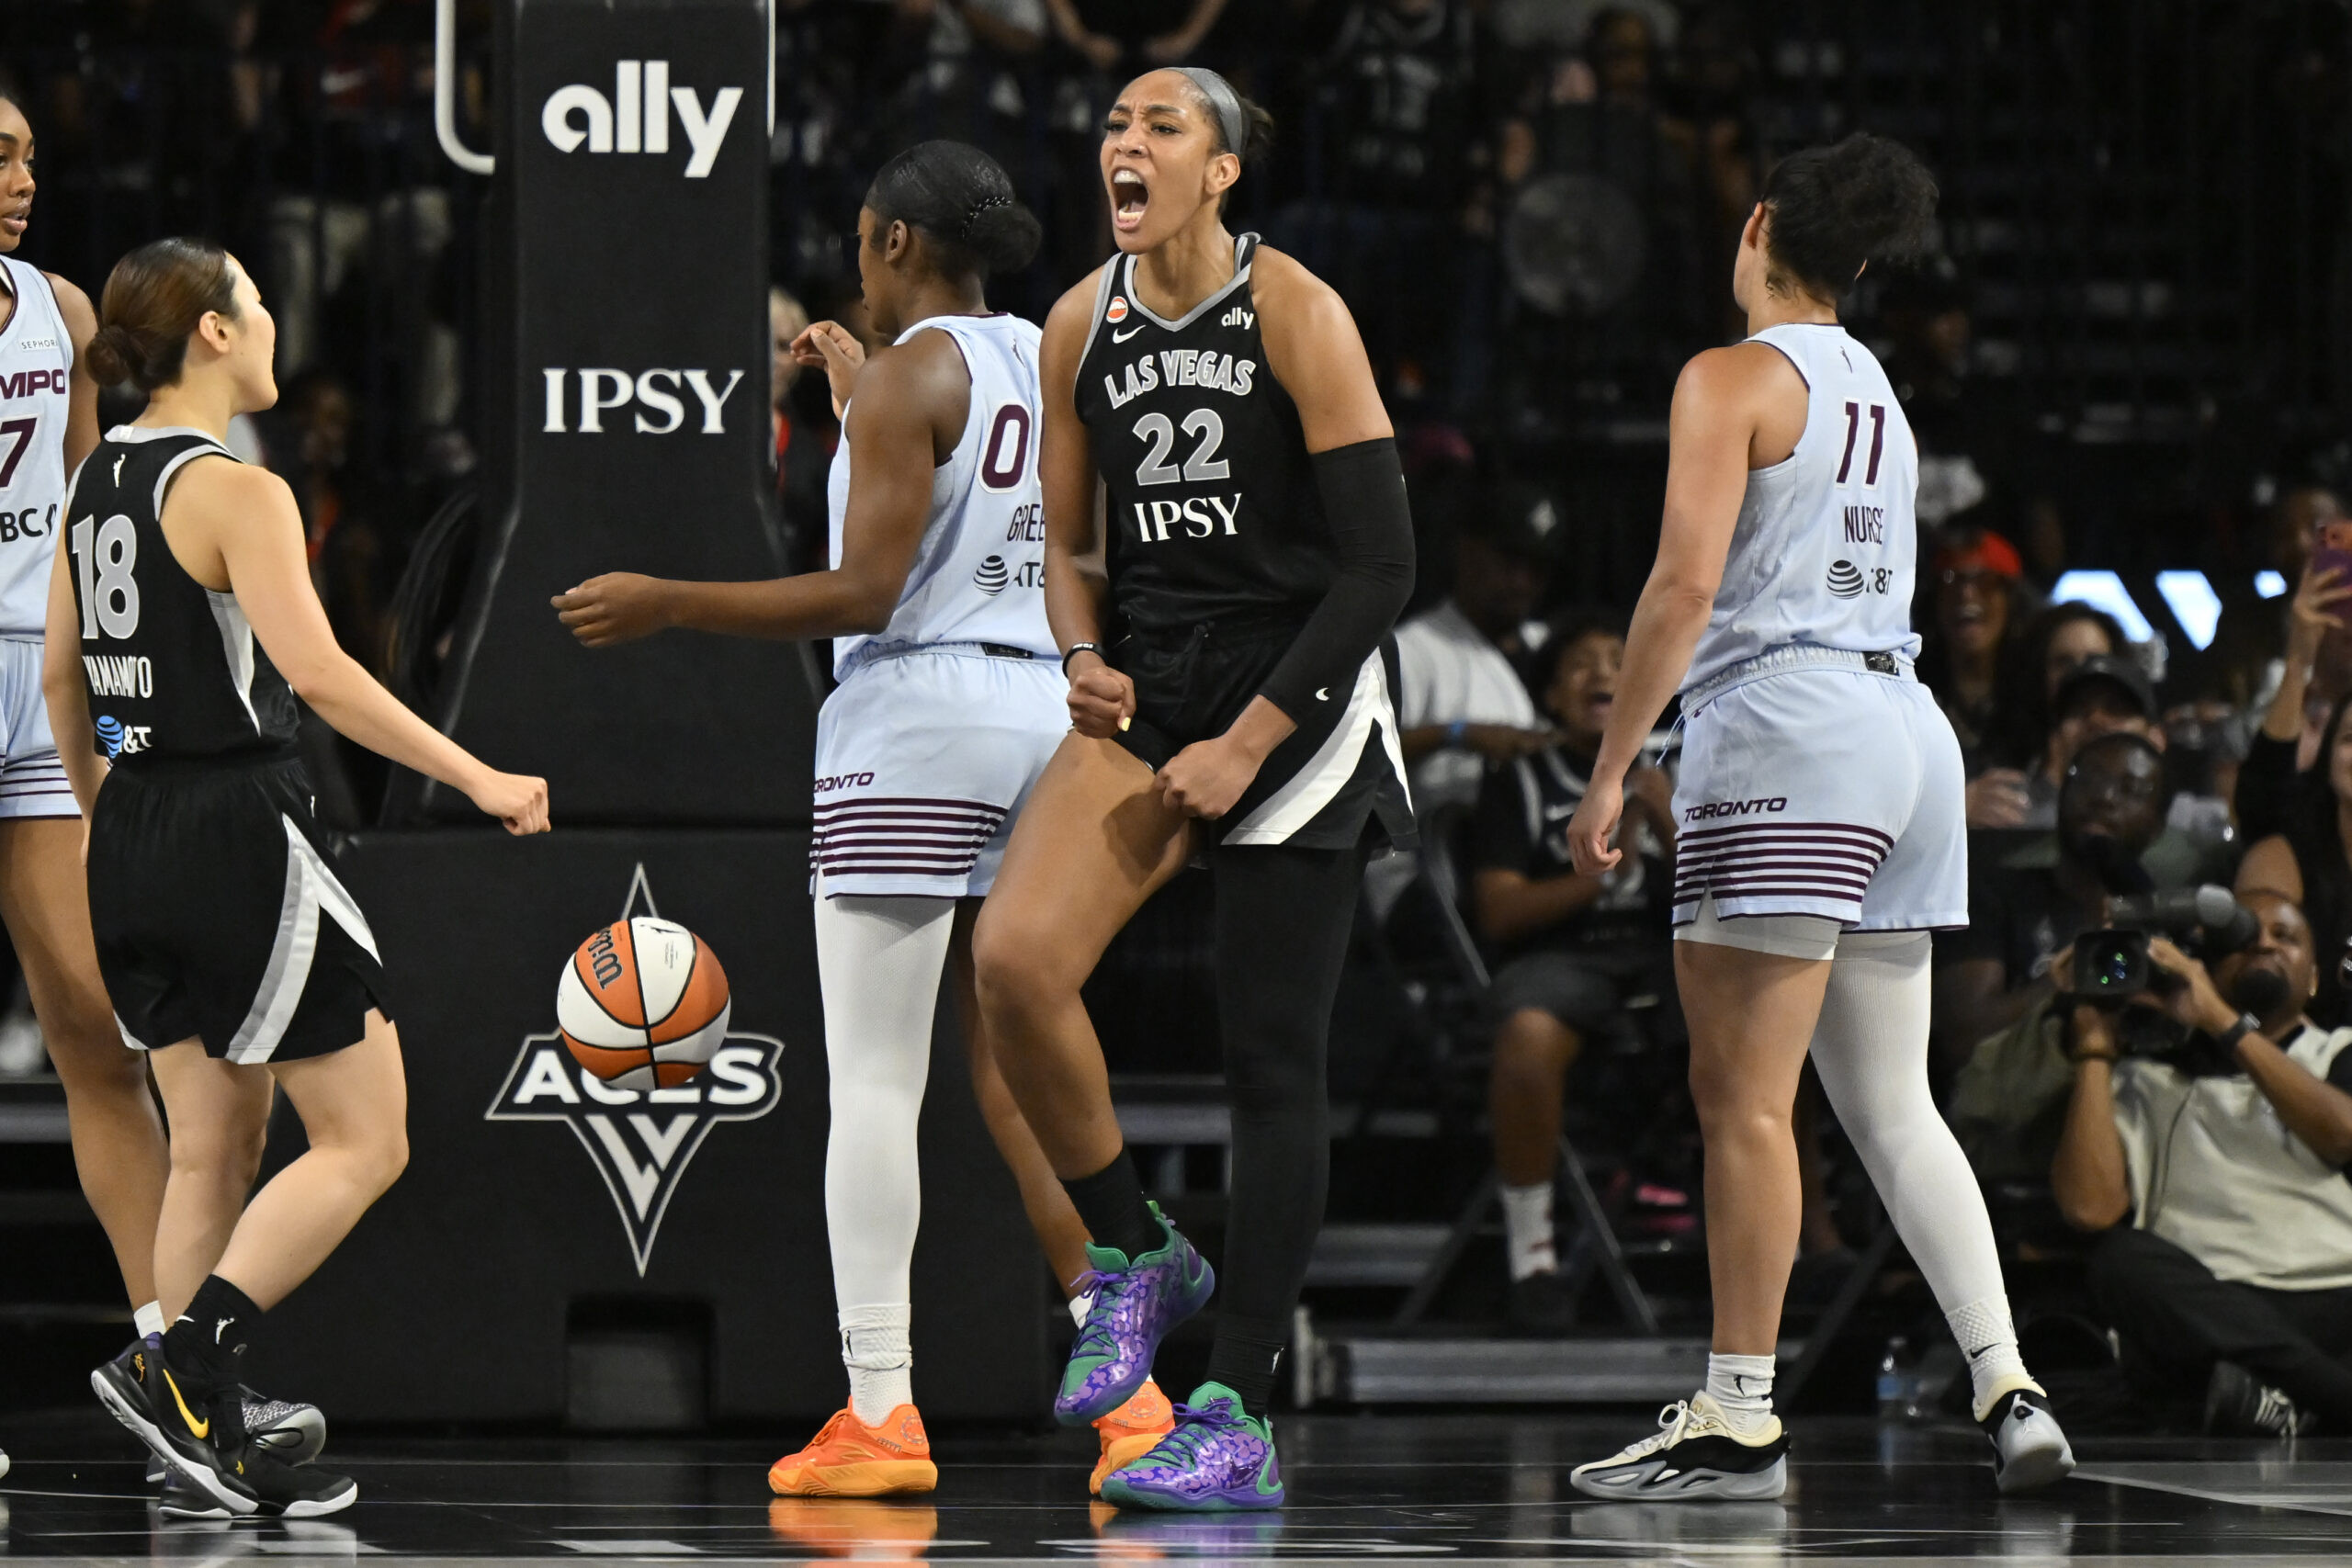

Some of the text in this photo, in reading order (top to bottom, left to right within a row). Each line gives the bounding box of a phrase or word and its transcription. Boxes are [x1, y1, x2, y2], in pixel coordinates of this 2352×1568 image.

[542, 60, 743, 177] ally
[1221, 307, 1254, 330] ally
[543, 368, 744, 434] IPSY
[1104, 350, 1256, 410] LAS VEGAS
[0, 415, 40, 491] 7
[978, 401, 1044, 493] 0
[1132, 408, 1230, 486] 22
[1834, 397, 1886, 491] 11
[1134, 492, 1242, 542] IPSY
[72, 513, 141, 640] 18
[1685, 797, 1787, 822] TORONTO
